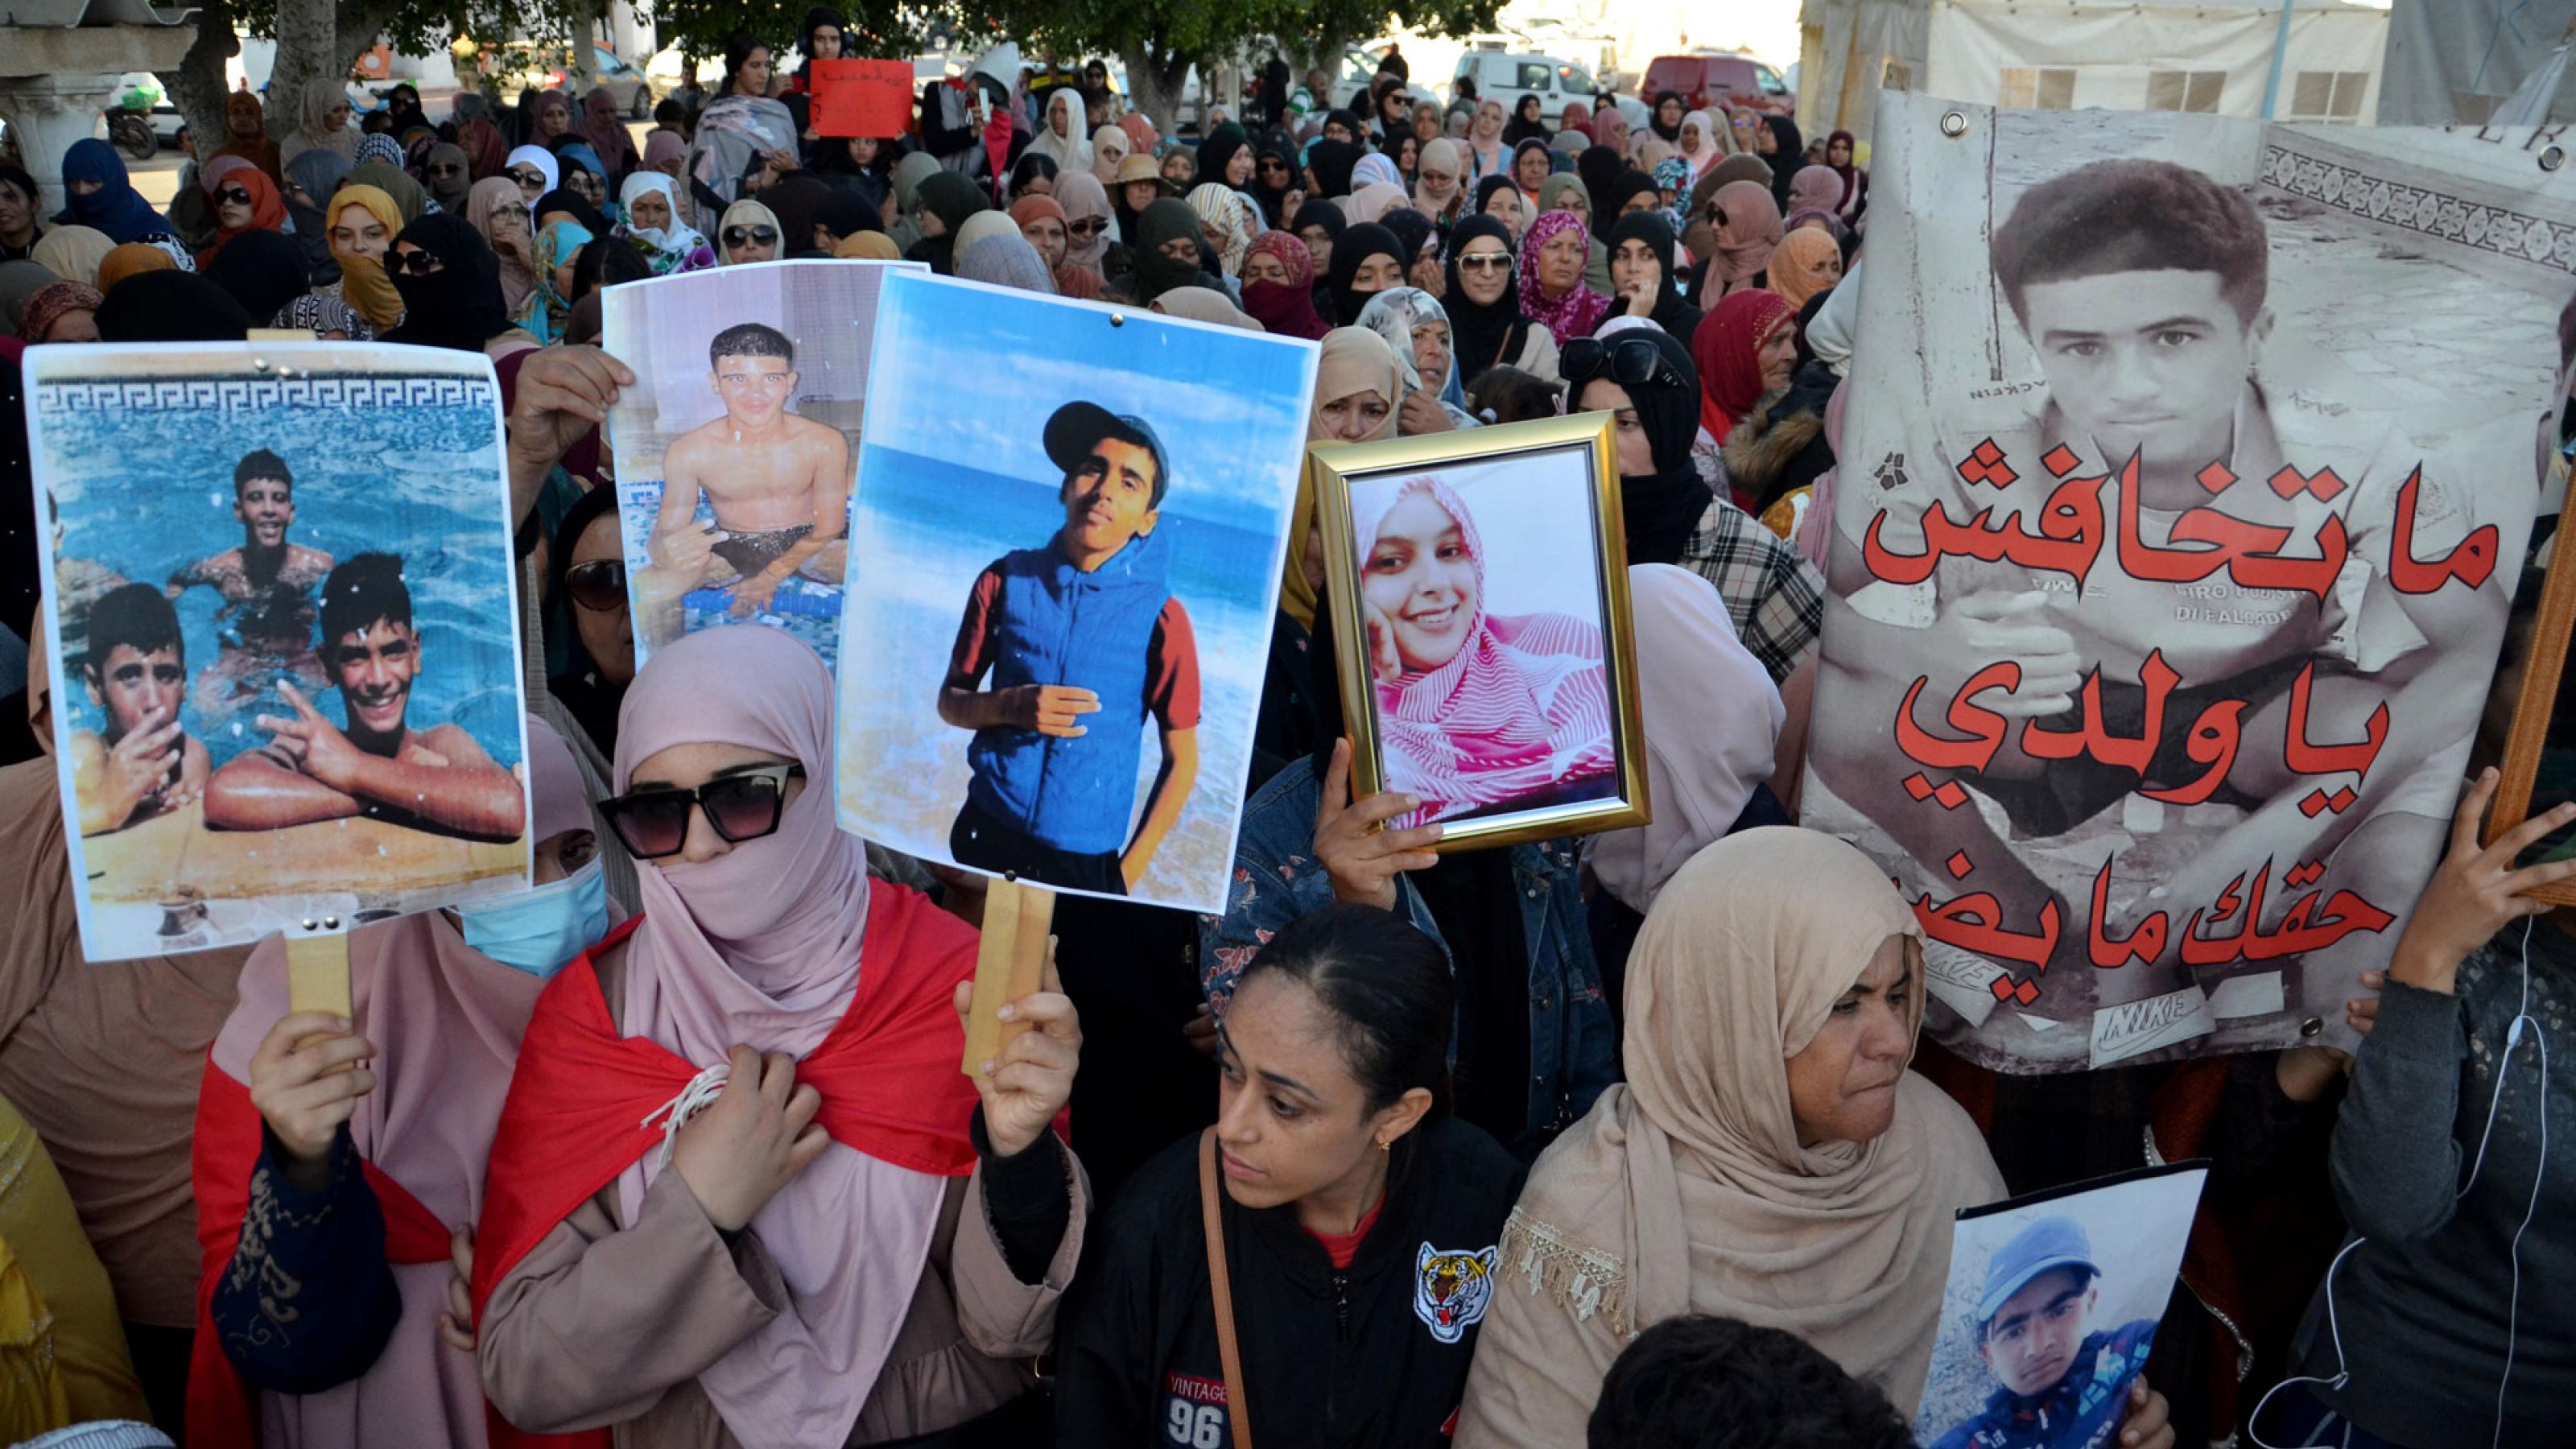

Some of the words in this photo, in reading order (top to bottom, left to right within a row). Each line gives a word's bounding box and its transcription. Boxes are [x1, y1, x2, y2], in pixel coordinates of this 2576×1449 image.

[1862, 438, 2349, 617] تخافش
[2388, 460, 2500, 595] ما
[2176, 606, 2198, 620] DI
[1893, 648, 2250, 810] ولدي
[2283, 659, 2392, 819] يا
[2087, 852, 2169, 968] ما
[2180, 852, 2396, 966] حقك
[2099, 993, 2185, 1042] NIKE
[1167, 1397, 1224, 1449] 96
[1171, 1376, 1228, 1402] VINTAGE
